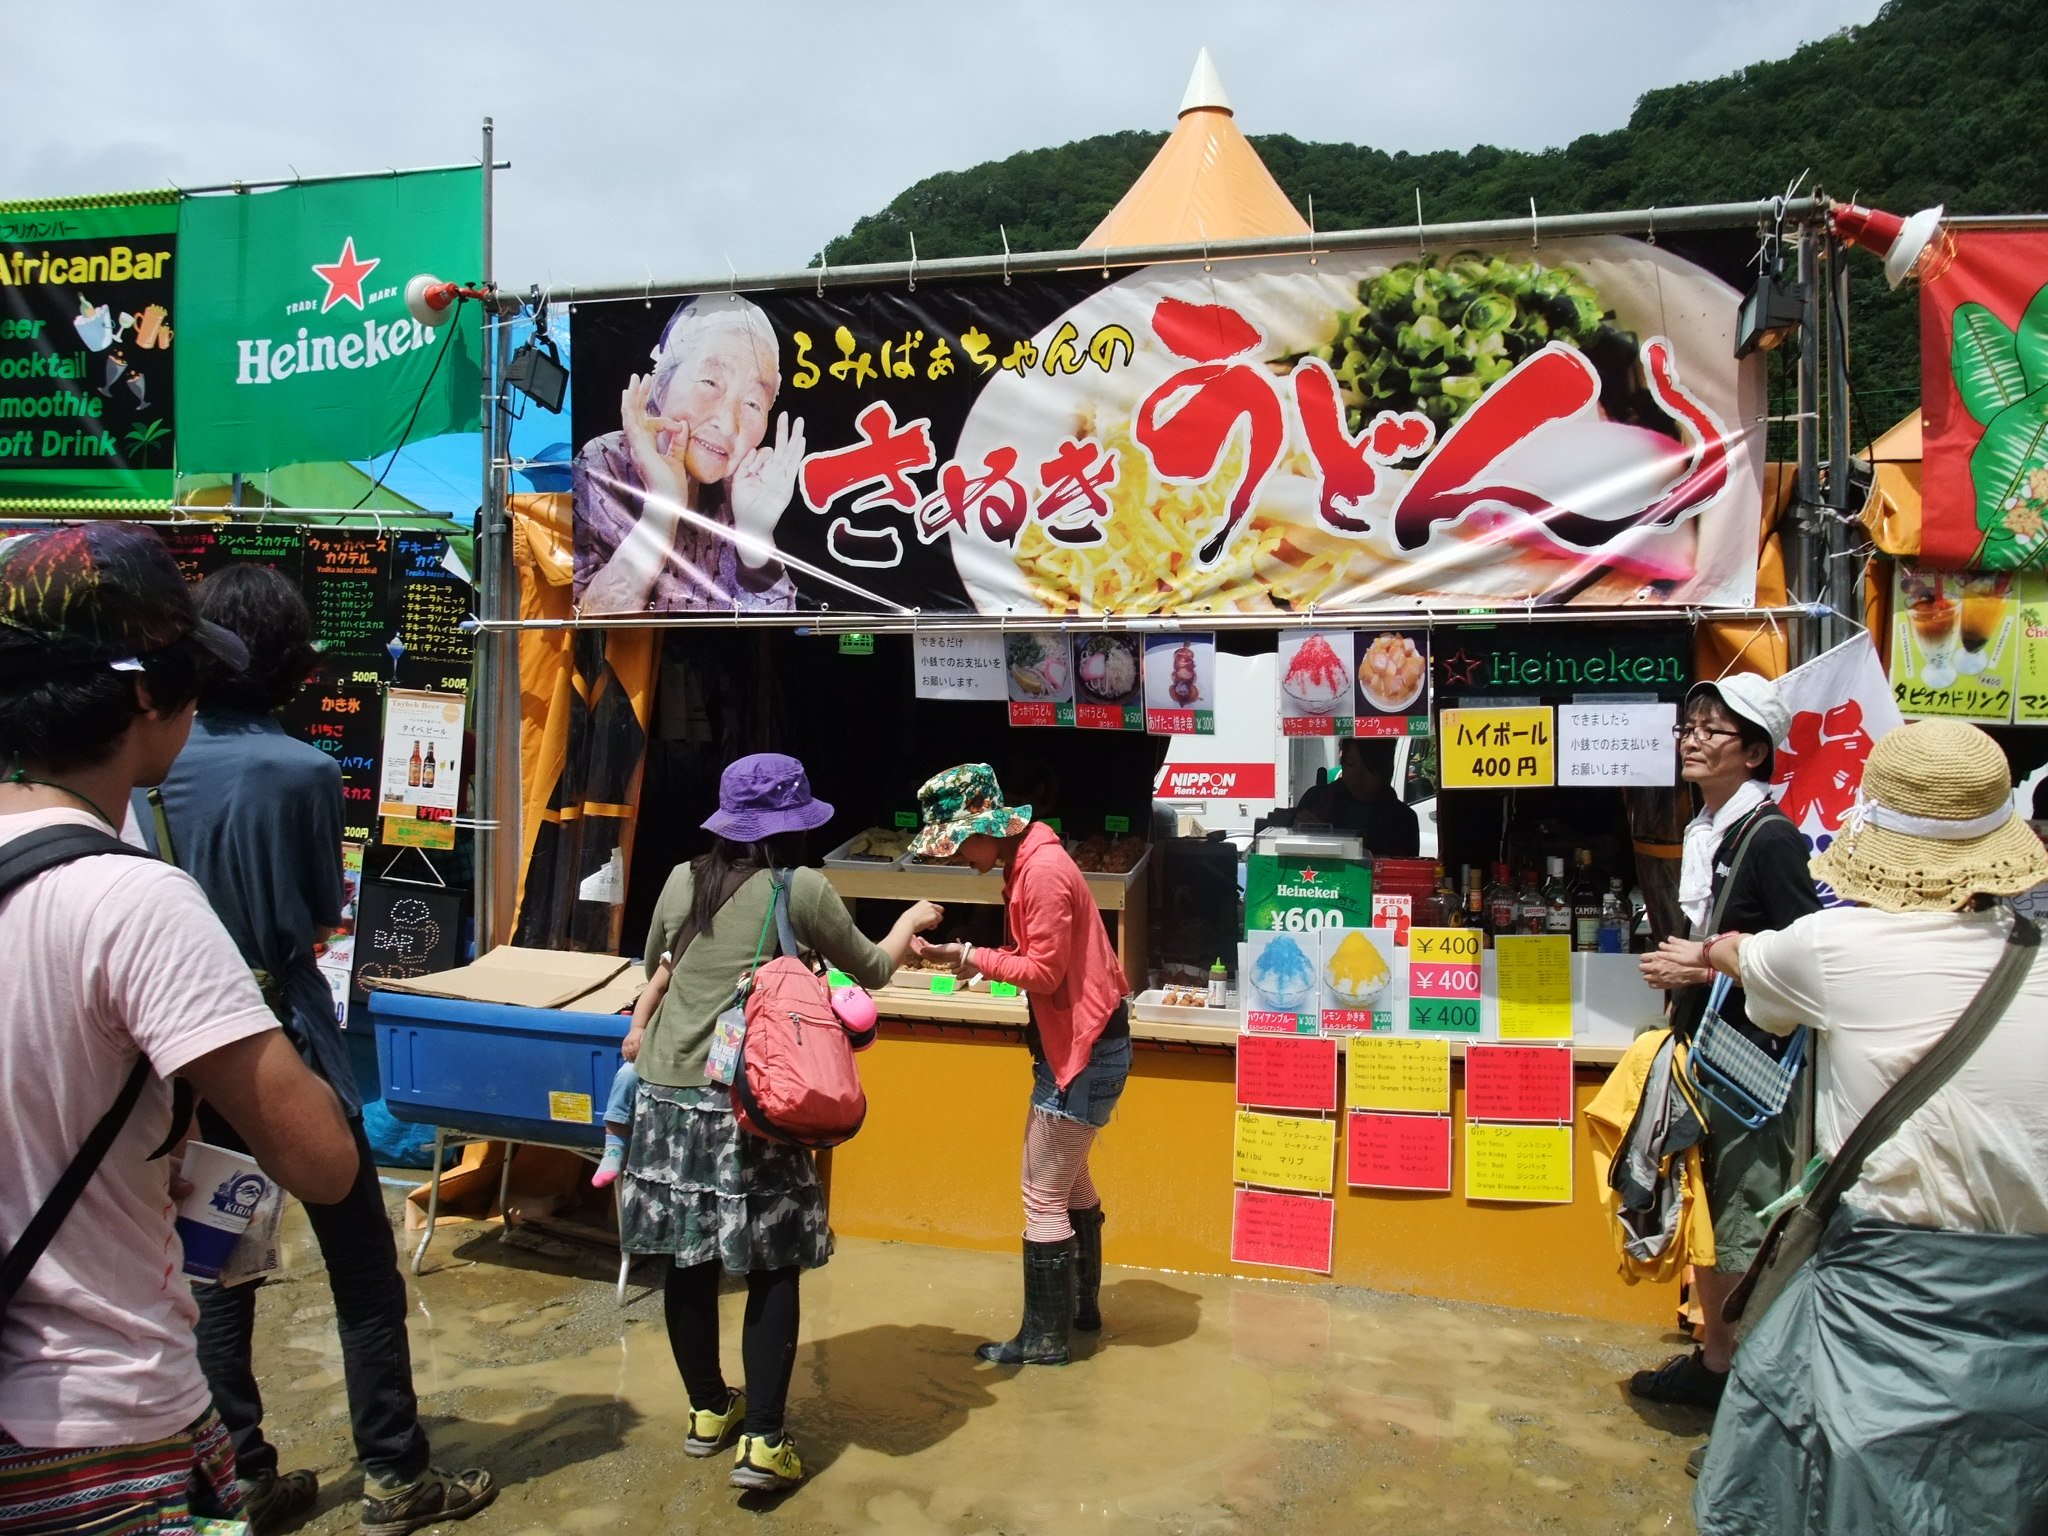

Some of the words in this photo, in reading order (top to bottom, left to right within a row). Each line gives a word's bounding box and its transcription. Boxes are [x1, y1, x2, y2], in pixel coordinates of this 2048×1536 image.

[0, 221, 78, 239] フリカンバー
[286, 299, 318, 316] TRADE
[368, 286, 398, 304] MARK
[0, 319, 47, 340] eer
[236, 317, 436, 385] Heineken
[792, 322, 1135, 389] るみばぁちゃんの
[0, 351, 87, 380] ocktail
[0, 390, 103, 418] moothie
[0, 430, 34, 457] oft
[41, 429, 117, 457] Drink
[218, 535, 301, 547] ジンベースカクテル
[308, 538, 387, 552] ウォッカベース
[325, 552, 370, 565] カクテル
[921, 637, 963, 648] できるだけ
[921, 656, 1001, 669] 小銭でのお支払いを
[1489, 648, 1685, 685] Heineken
[352, 671, 379, 683] 500円
[441, 677, 468, 689] 500円
[922, 676, 979, 688] お願いします。
[1894, 682, 2010, 711] タピオカドリンク
[2019, 694, 2048, 710] マン
[321, 697, 361, 713] かき氷
[1012, 704, 1052, 717] ぶっかけうどん
[1079, 706, 1108, 718] かけうどん
[1147, 714, 1193, 731] あげたこ焼き串
[1284, 718, 1303, 728] いちご
[1308, 717, 1328, 728] かき氷
[1355, 718, 1380, 729] マンゴウ
[1571, 712, 1629, 727] できましたら
[311, 724, 345, 737] いちご
[1377, 728, 1400, 736] かき氷
[1456, 721, 1548, 747] ハイボール
[313, 739, 343, 752] メロン
[1571, 737, 1660, 751] 小銭でのお支払いを
[338, 757, 374, 769] ハワイ
[1472, 757, 1511, 778] 400
[1517, 756, 1537, 777] 円
[1571, 763, 1634, 776] お願いします。
[1170, 773, 1236, 787] NIPPON
[1173, 786, 1229, 796] Rent-A-Car
[344, 827, 369, 838] 300円
[1277, 885, 1338, 899] Heineken
[1575, 906, 1600, 915] CAMPA
[1271, 906, 1344, 932] ¥600
[374, 930, 414, 952] BAR
[1248, 1013, 1295, 1024] ハワイアンブルー
[1323, 1012, 1341, 1021] レモン
[1346, 1012, 1366, 1022] かき氷
[1276, 1041, 1300, 1049] カシス
[1352, 1038, 1382, 1047] Tequila
[1387, 1040, 1422, 1049] テキーラ
[1277, 1120, 1301, 1129] ピーチ
[1471, 1128, 1485, 1136] Gin
[1494, 1128, 1512, 1137] ジン
[1237, 1151, 1262, 1161] Malibu
[1279, 1156, 1304, 1165] マリブ
